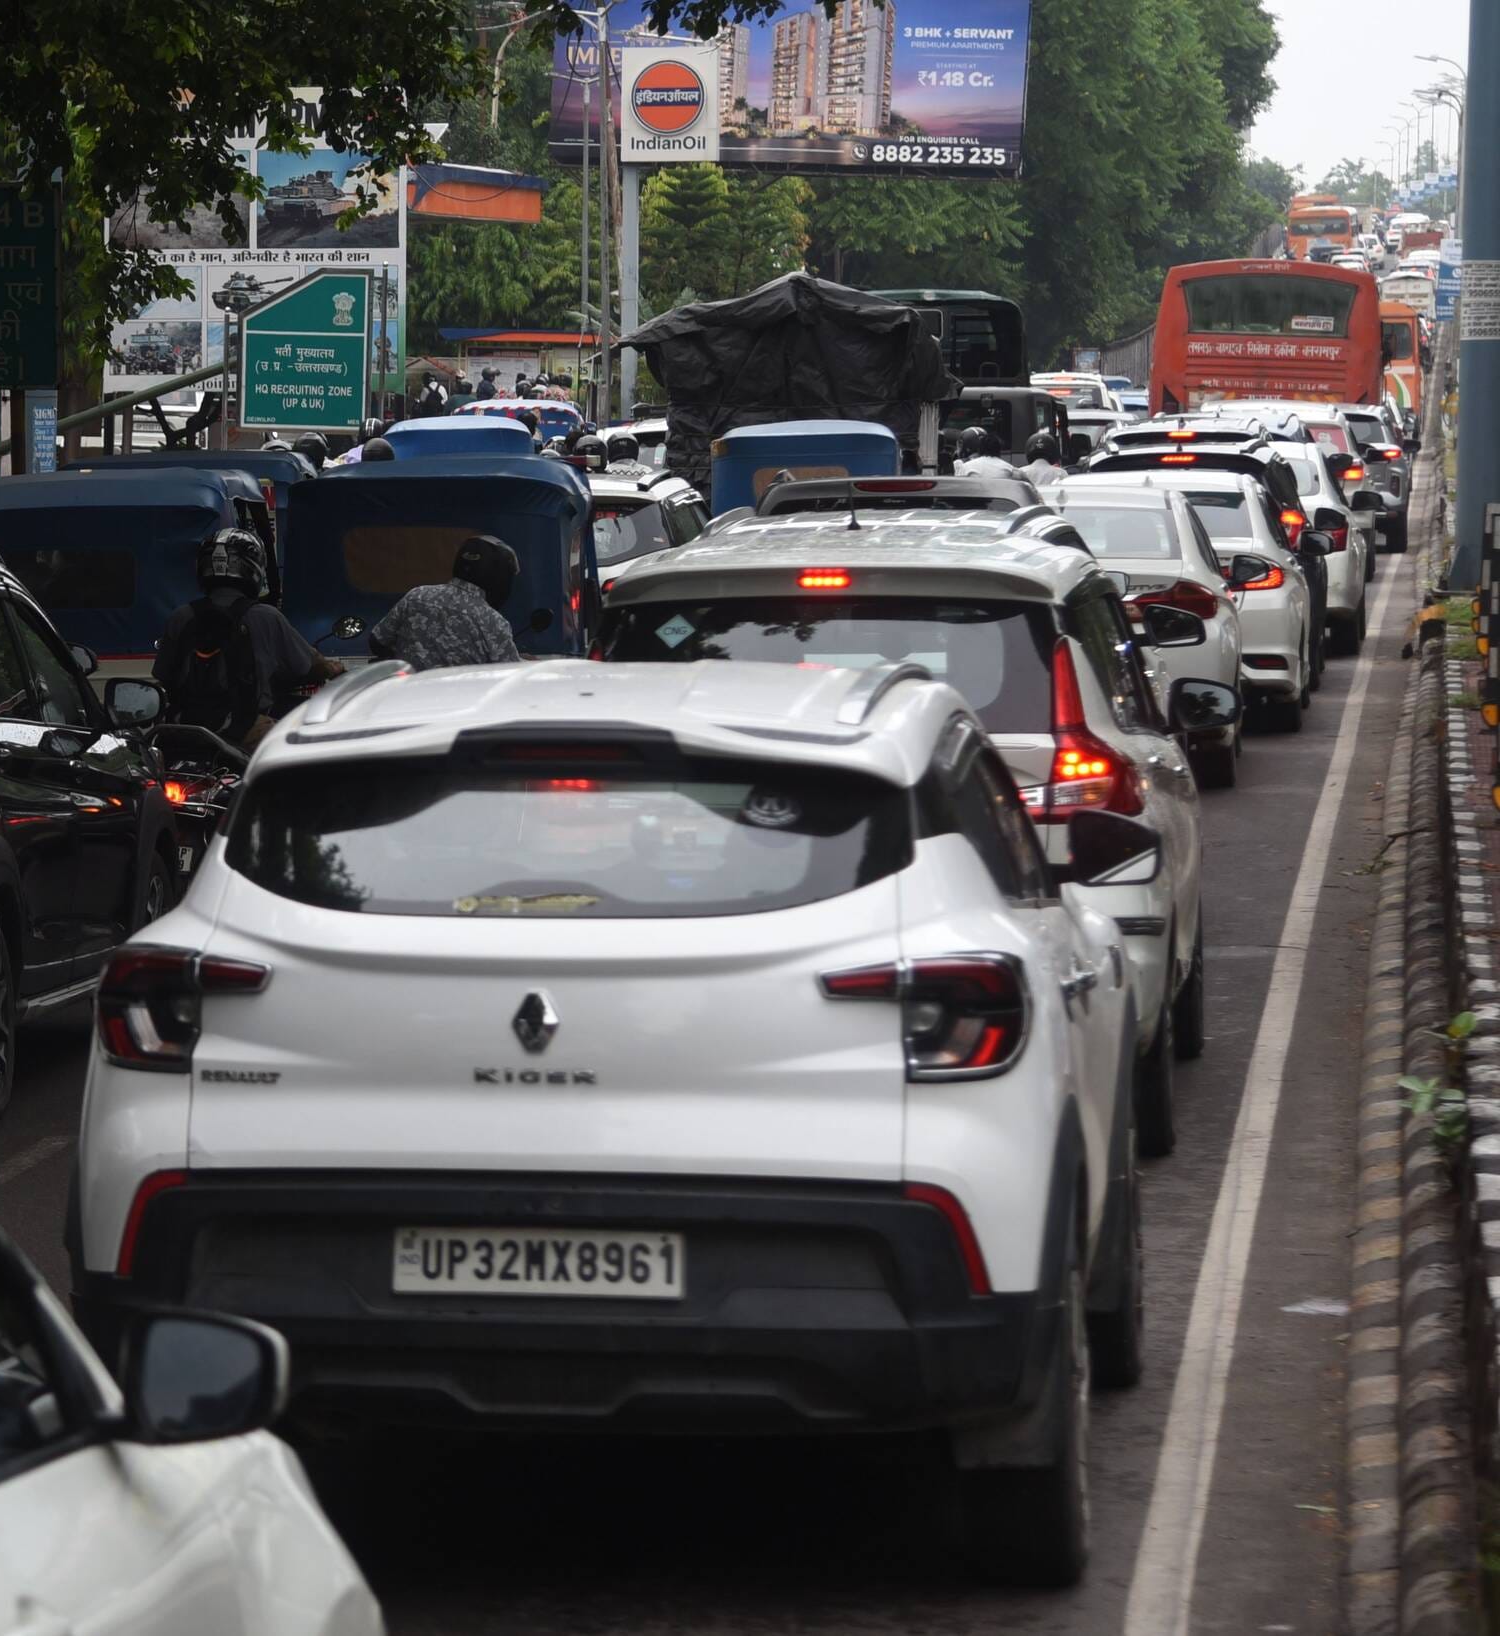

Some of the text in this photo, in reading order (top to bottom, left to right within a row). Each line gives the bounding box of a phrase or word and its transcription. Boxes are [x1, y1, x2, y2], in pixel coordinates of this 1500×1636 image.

[903, 27, 912, 37] 3
[914, 27, 942, 38] BHK
[953, 28, 1014, 40] SERVANT
[910, 41, 1005, 51] PREMIUM APARTMENTS
[918, 70, 964, 87] ₹1.18
[635, 88, 699, 105] इंडियनऑयल
[631, 136, 706, 150] IndianOil
[900, 135, 980, 145] FOR ENQUIRIES CALL
[872, 144, 1006, 165] 8882 235 235
[171, 251, 185, 263] का
[189, 250, 197, 263] है
[283, 250, 291, 263] है
[295, 251, 324, 263] भारत
[328, 250, 343, 263] की
[275, 344, 335, 362] भर्ती मुख्यालय
[255, 384, 353, 397] HQ RECRUITING ZONE
[282, 398, 325, 411] (UP & UK)
[200, 1067, 598, 1086] RENAULT KIGER
[421, 1234, 677, 1286] UP32MX8961
